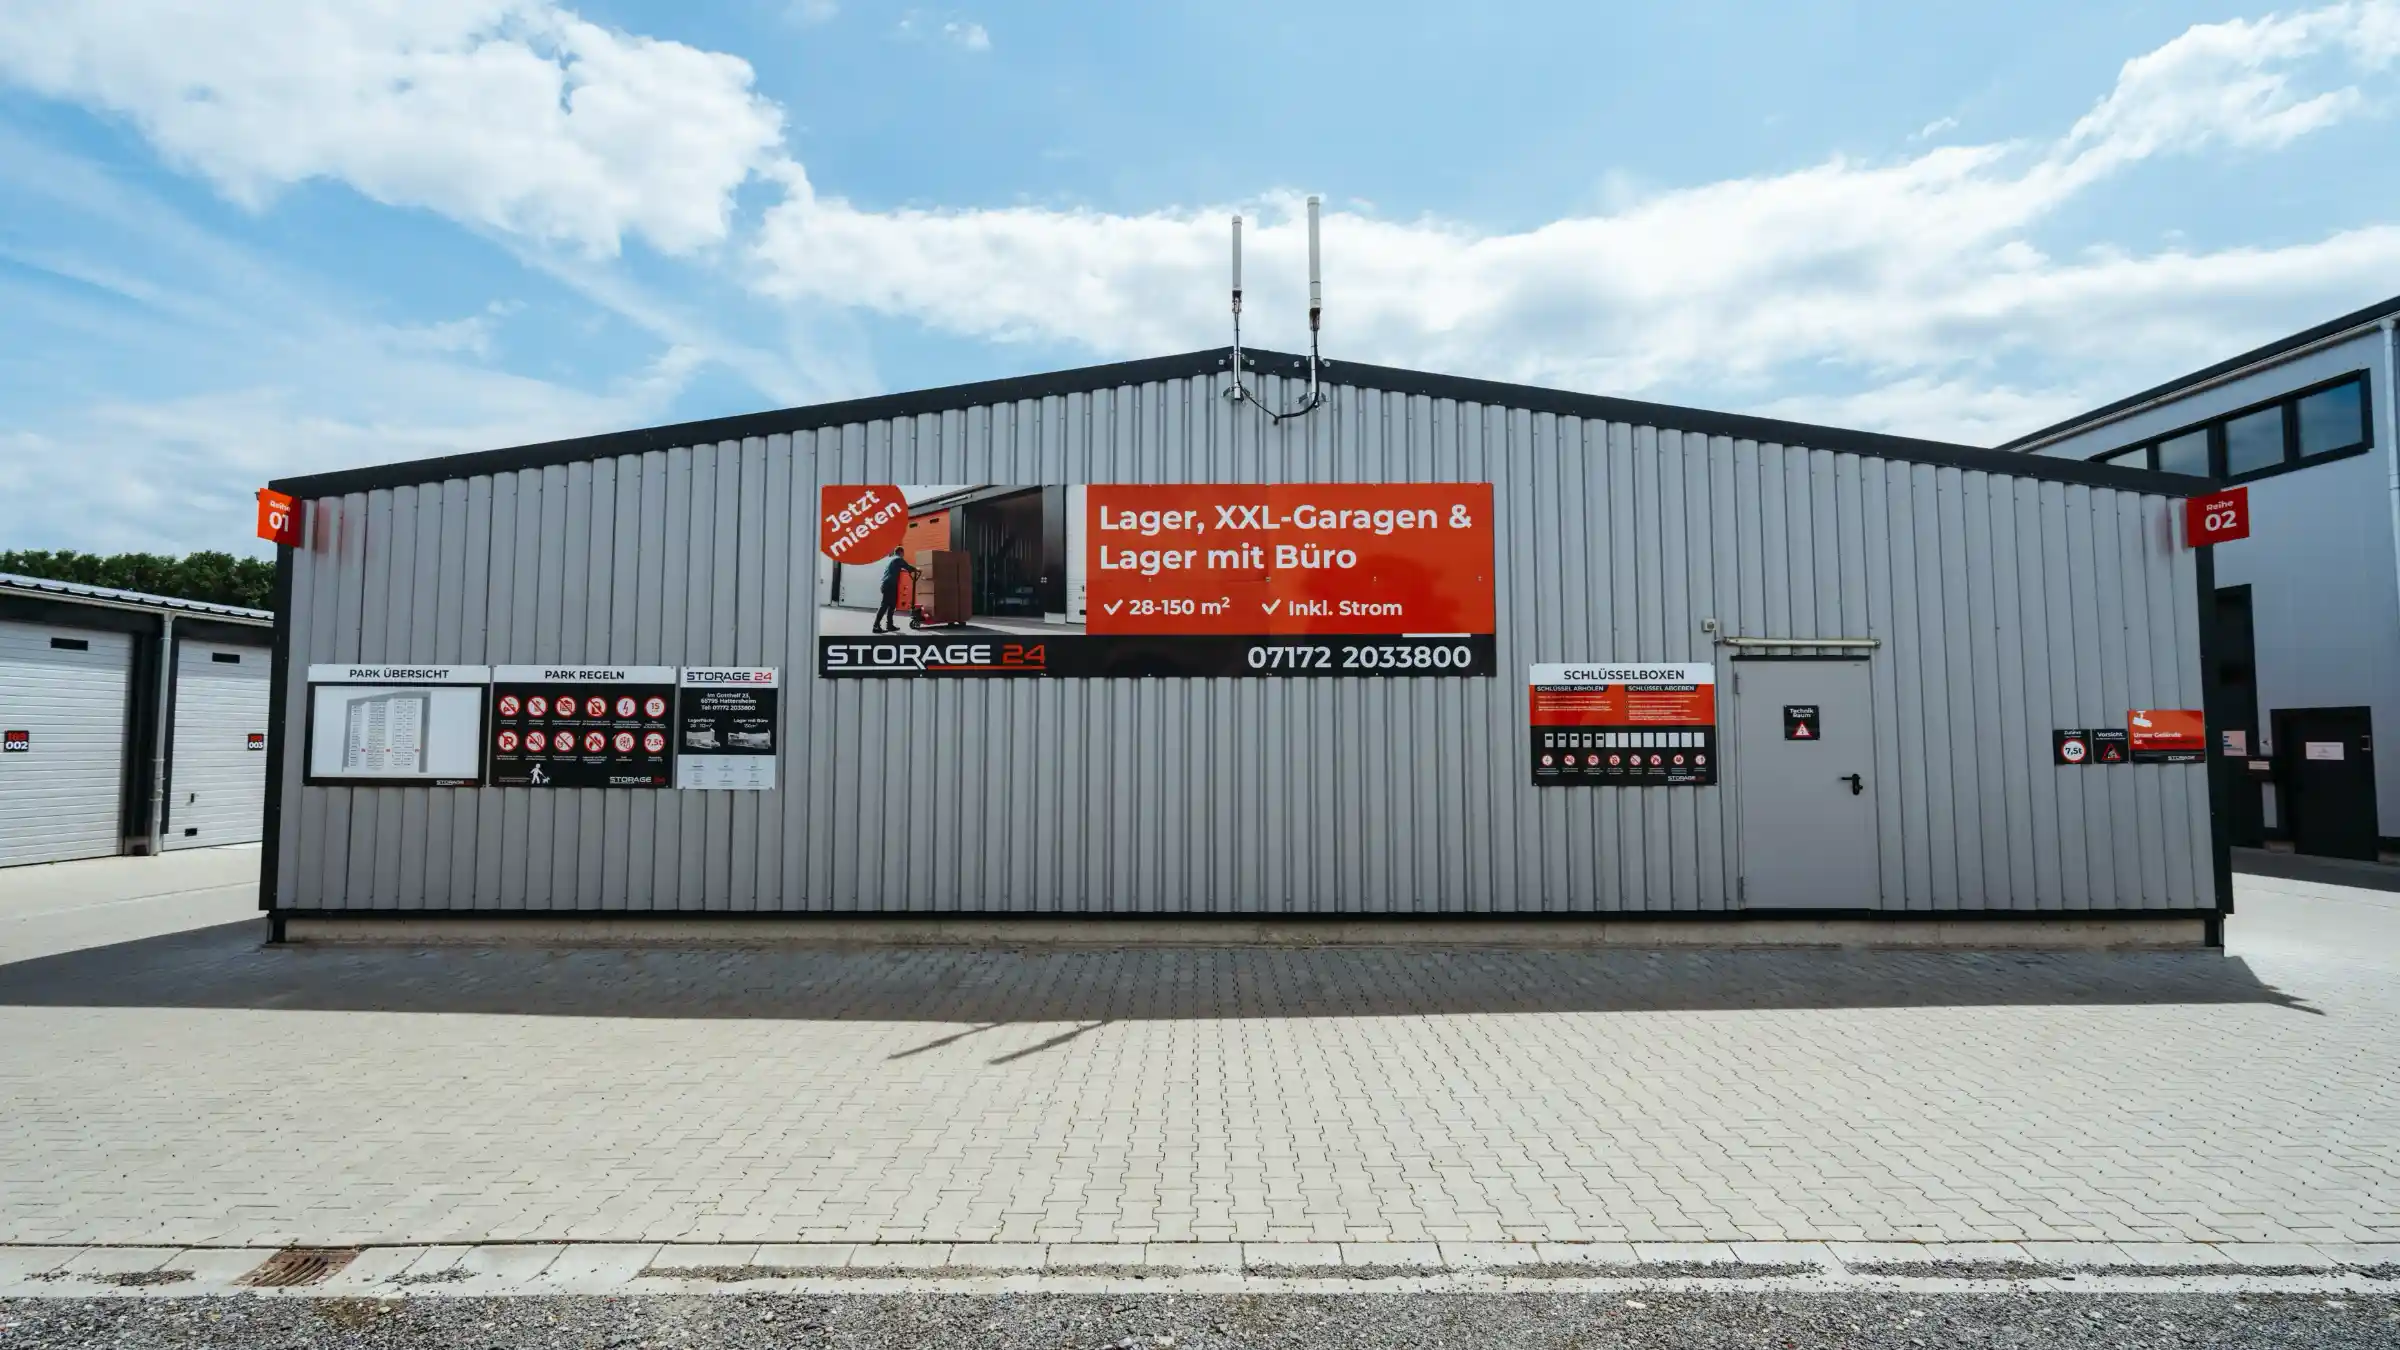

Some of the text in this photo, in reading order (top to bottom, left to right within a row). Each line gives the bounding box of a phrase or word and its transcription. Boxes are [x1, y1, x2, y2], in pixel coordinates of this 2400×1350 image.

[269, 500, 291, 512] Reihe
[825, 489, 880, 533] Jetzt
[2206, 501, 2234, 511] Reihe
[269, 511, 289, 532] 01
[1100, 504, 1472, 536] Lager, XXL-Garagen &
[2205, 510, 2237, 531] 02
[829, 499, 902, 557] mieten
[1100, 543, 1357, 575] Lager mit Büro
[1129, 599, 1195, 616] 28-150
[1289, 599, 1333, 616] Inkl.
[1339, 599, 1403, 616] Strom
[827, 644, 1046, 668] STORAGE 24
[1248, 645, 1472, 669] 07172 2033800
[350, 667, 449, 680] PARK ÜBERSICHT
[545, 670, 625, 680] PARK REGELN
[687, 671, 772, 682] STORAGE 24
[1564, 668, 1685, 681] SCHLÜSSELBOXEN
[6, 741, 28, 750] 002
[248, 741, 264, 749] 003
[609, 776, 652, 784] STORAGE
